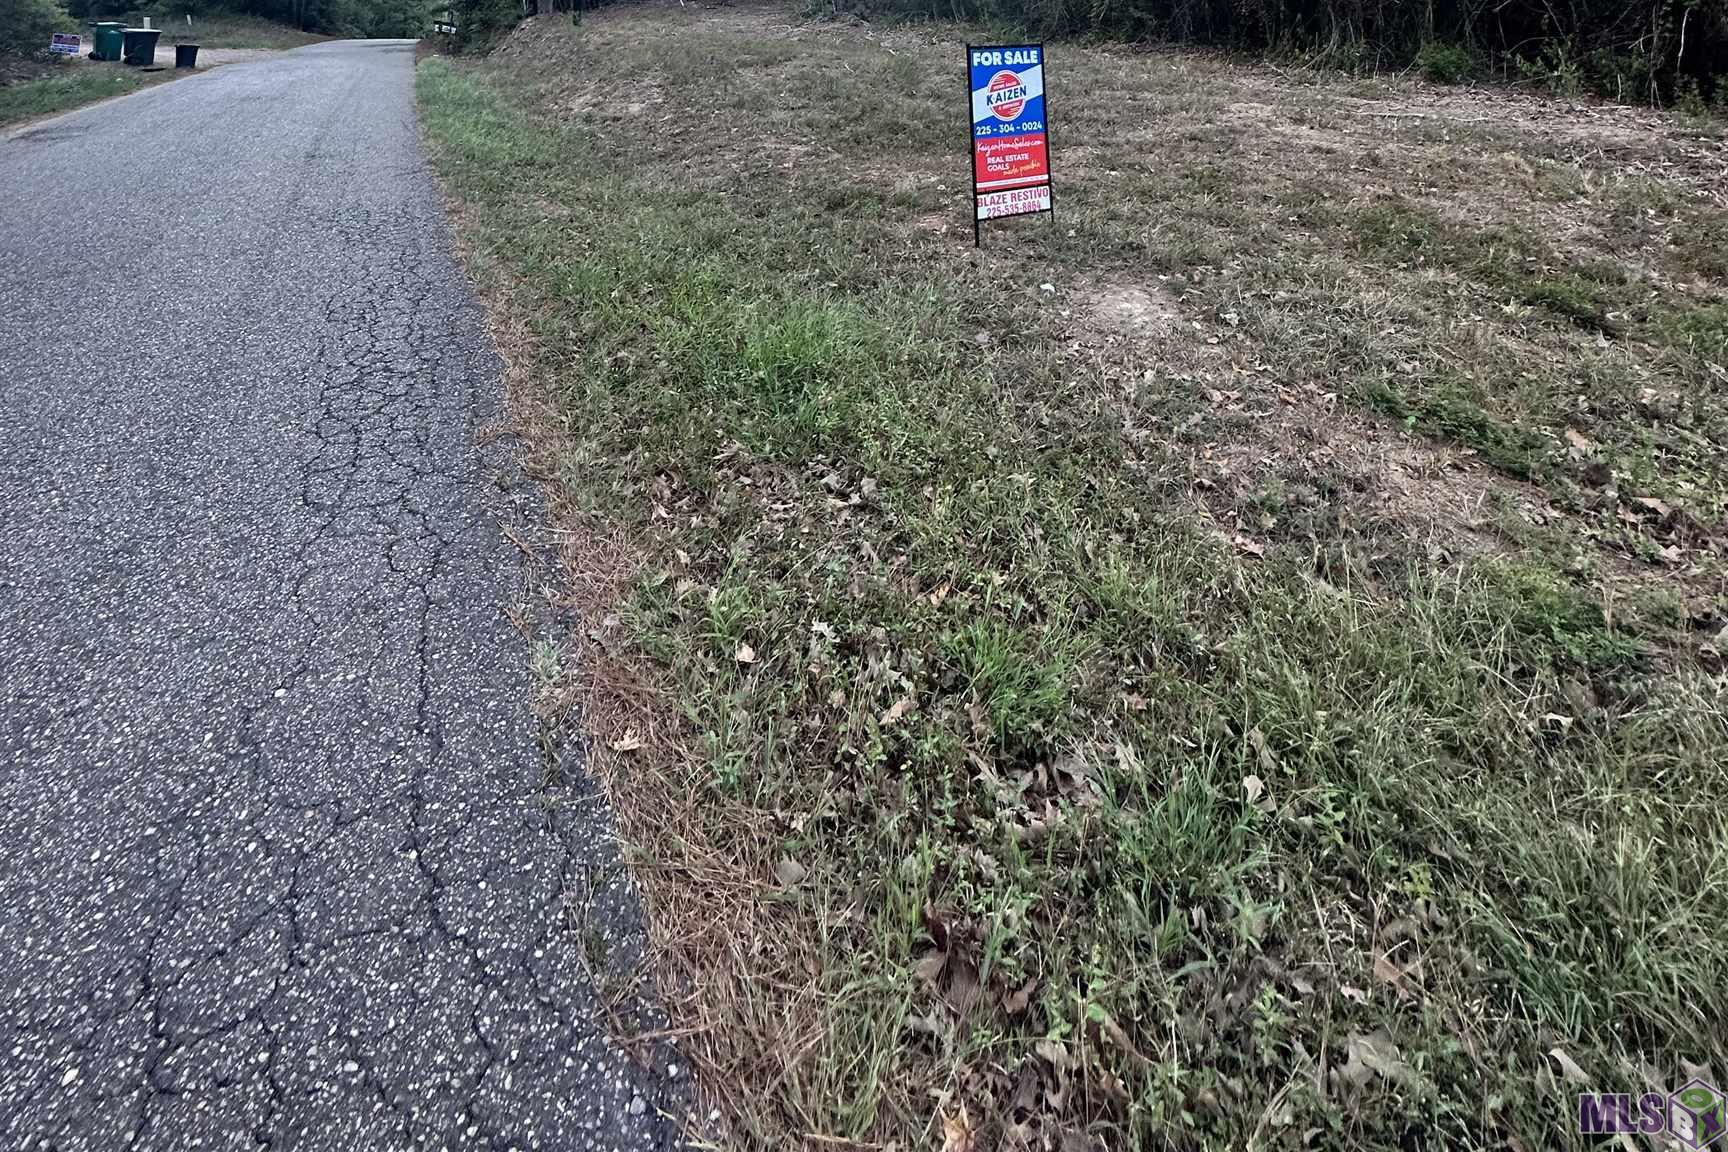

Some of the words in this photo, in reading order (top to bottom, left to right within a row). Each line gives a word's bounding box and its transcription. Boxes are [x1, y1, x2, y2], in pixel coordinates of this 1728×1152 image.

[973, 51, 1002, 66] FOR
[1004, 50, 1038, 65] SALE
[986, 85, 1027, 106] KAIZEN
[976, 125, 992, 135] 225
[1000, 123, 1015, 133] 304
[1022, 120, 1042, 130] 0024
[987, 155, 1005, 164] REAL
[1005, 153, 1029, 162] ESTATE
[987, 163, 1009, 172] GOALS
[977, 193, 1008, 208] BLAZE
[1010, 187, 1049, 203] RESTIVO
